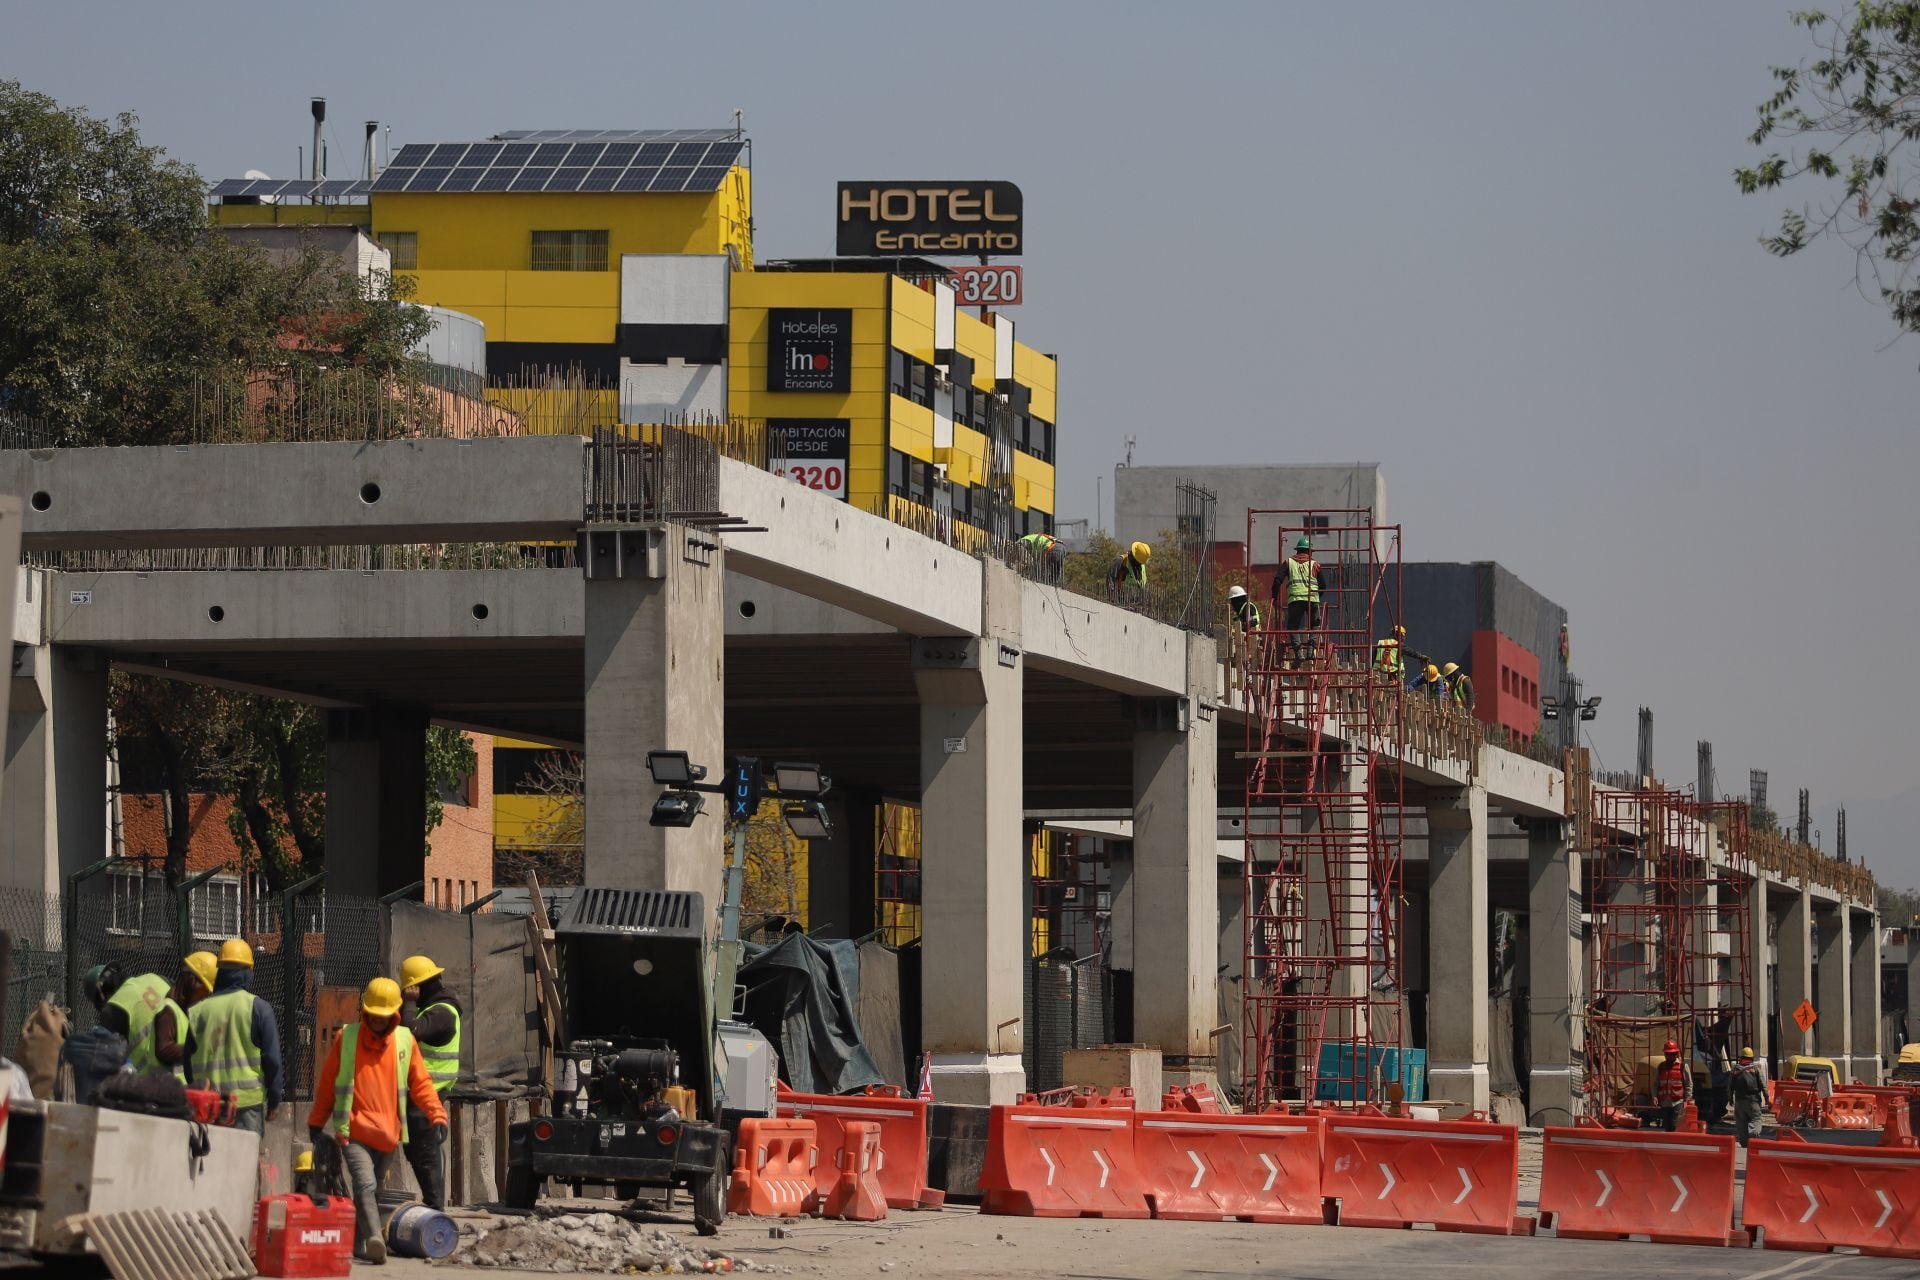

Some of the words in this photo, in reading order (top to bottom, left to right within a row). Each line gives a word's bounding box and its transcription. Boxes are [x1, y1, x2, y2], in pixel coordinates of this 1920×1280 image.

[841, 188, 1018, 222] HOTEL
[875, 229, 1018, 250] Encanto
[782, 312, 838, 338] Hoteles
[785, 379, 833, 389] Encanto
[787, 441, 829, 452] DESDE
[736, 769, 749, 813] LUX
[301, 1229, 341, 1244] HILTI
